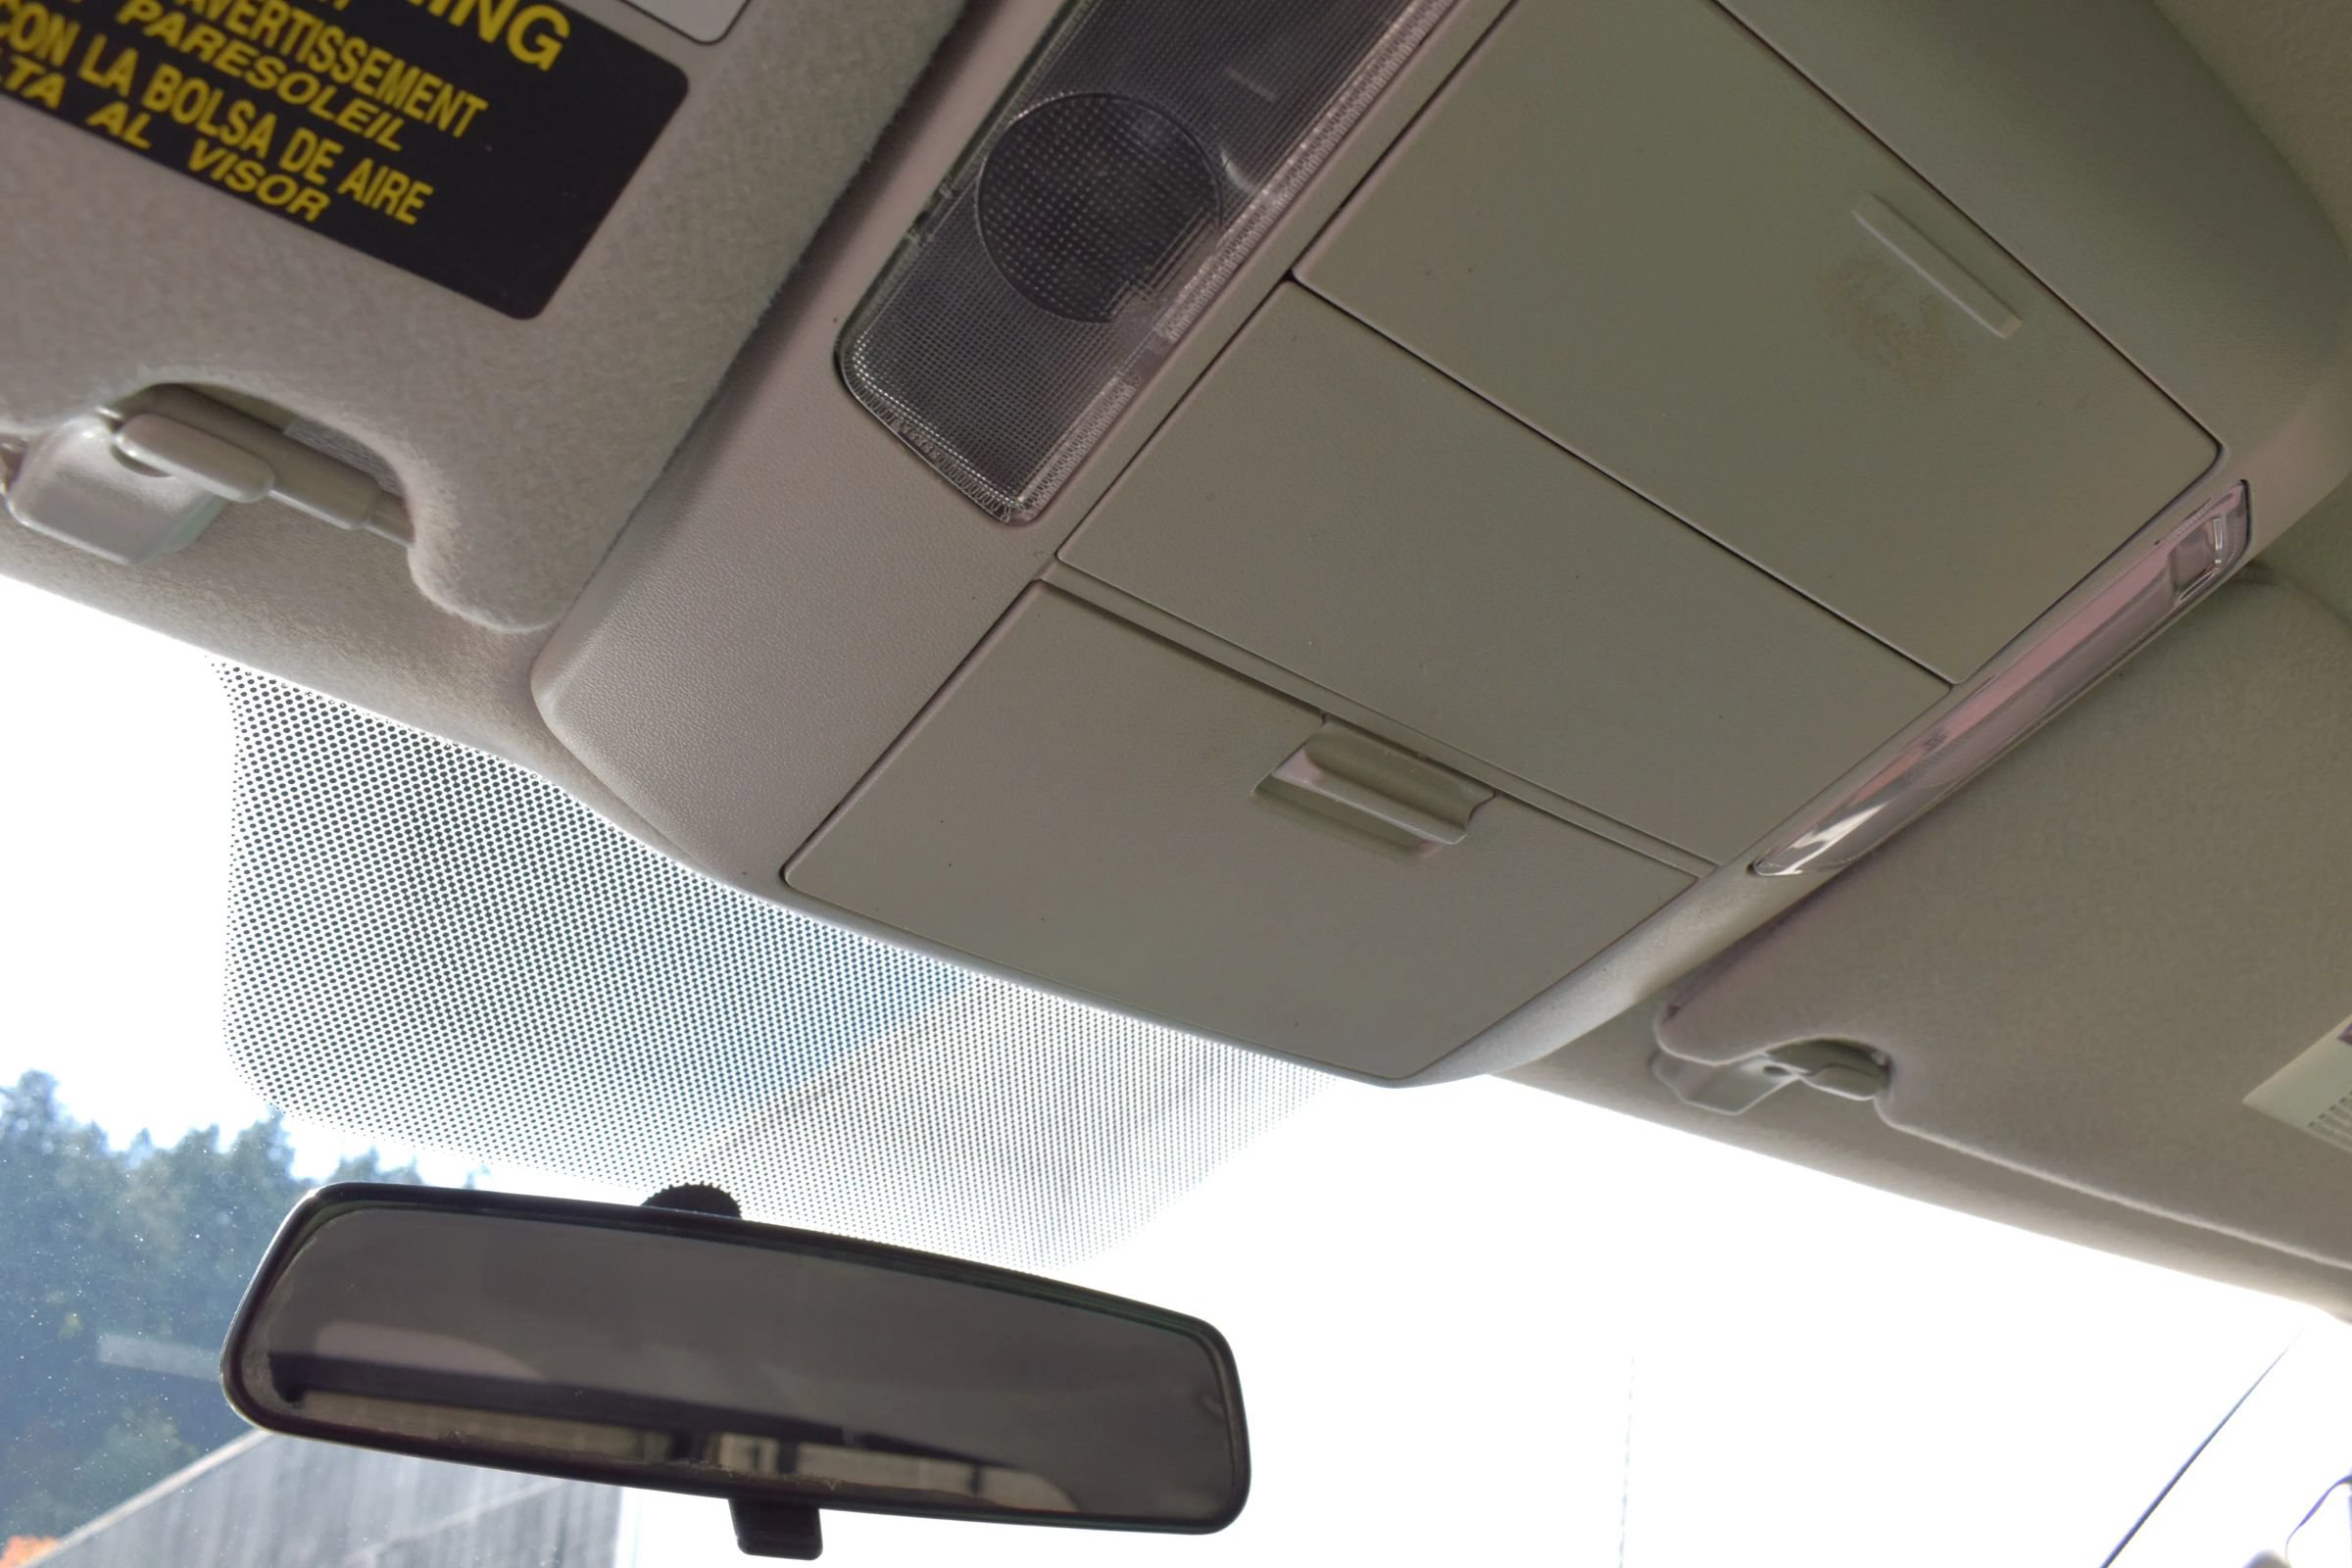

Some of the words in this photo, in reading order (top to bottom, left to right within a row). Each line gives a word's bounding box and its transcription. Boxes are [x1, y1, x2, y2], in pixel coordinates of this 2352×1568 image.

[116, 0, 404, 151] PARESOLEIL
[174, 0, 488, 138] ERTISSEMENT
[407, 0, 570, 71] NG
[0, 54, 66, 110] TA
[86, 101, 150, 149] AL
[188, 138, 331, 221] VISOR
[78, 33, 138, 96] LA
[143, 63, 277, 159] BOLSA
[279, 127, 344, 185] DE
[337, 158, 433, 225] AIRE
